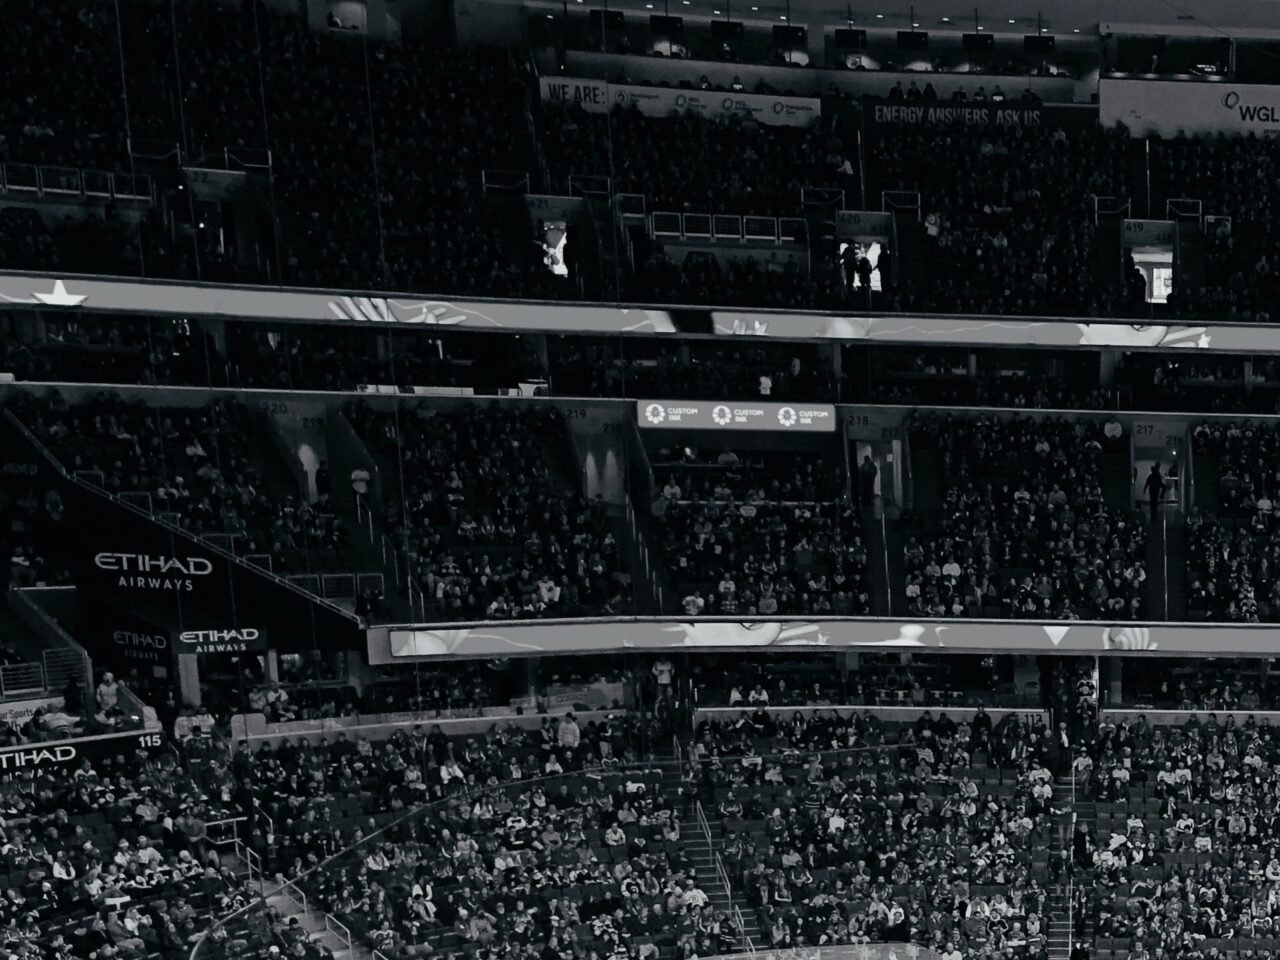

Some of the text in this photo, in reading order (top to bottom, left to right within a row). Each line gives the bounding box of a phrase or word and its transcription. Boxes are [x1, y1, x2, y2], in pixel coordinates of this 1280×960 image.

[875, 106, 924, 122] ENERGY
[996, 110, 1020, 125] ASK
[1024, 111, 1040, 126] US
[1239, 105, 1280, 123] WGL
[1136, 424, 1154, 435] 217
[1165, 435, 1184, 446] 216
[94, 552, 213, 575] ETIHAD
[118, 576, 194, 591] AIRWAYS
[113, 628, 259, 648] ETIHAD ETIHAD
[195, 643, 246, 652] AIRWAYS
[138, 735, 161, 747] 115
